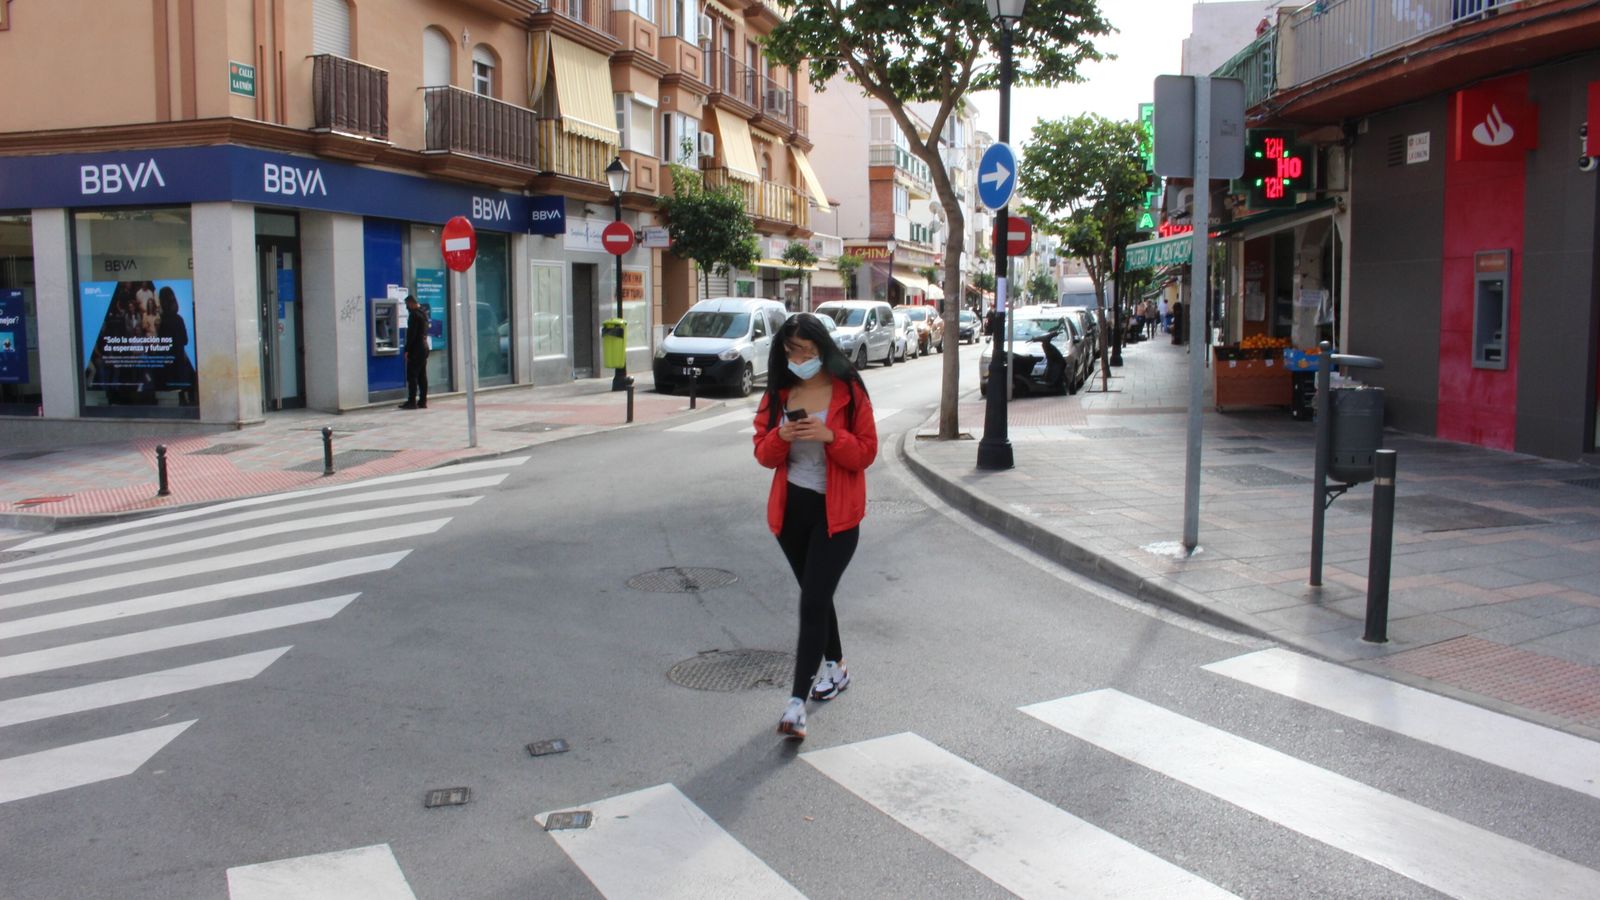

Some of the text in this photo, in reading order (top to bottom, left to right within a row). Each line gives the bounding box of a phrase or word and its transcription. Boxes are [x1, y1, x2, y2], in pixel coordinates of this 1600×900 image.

[1264, 137, 1284, 159] 12H
[80, 157, 166, 195] BBVA
[263, 162, 328, 197] BBVA
[1264, 177, 1284, 199] 12H
[472, 196, 512, 222] BBVA
[532, 209, 561, 221] BBVA
[855, 247, 891, 259] CHINA
[104, 258, 137, 272] BBVA
[113, 345, 144, 353] esperanza
[145, 345, 149, 353] y
